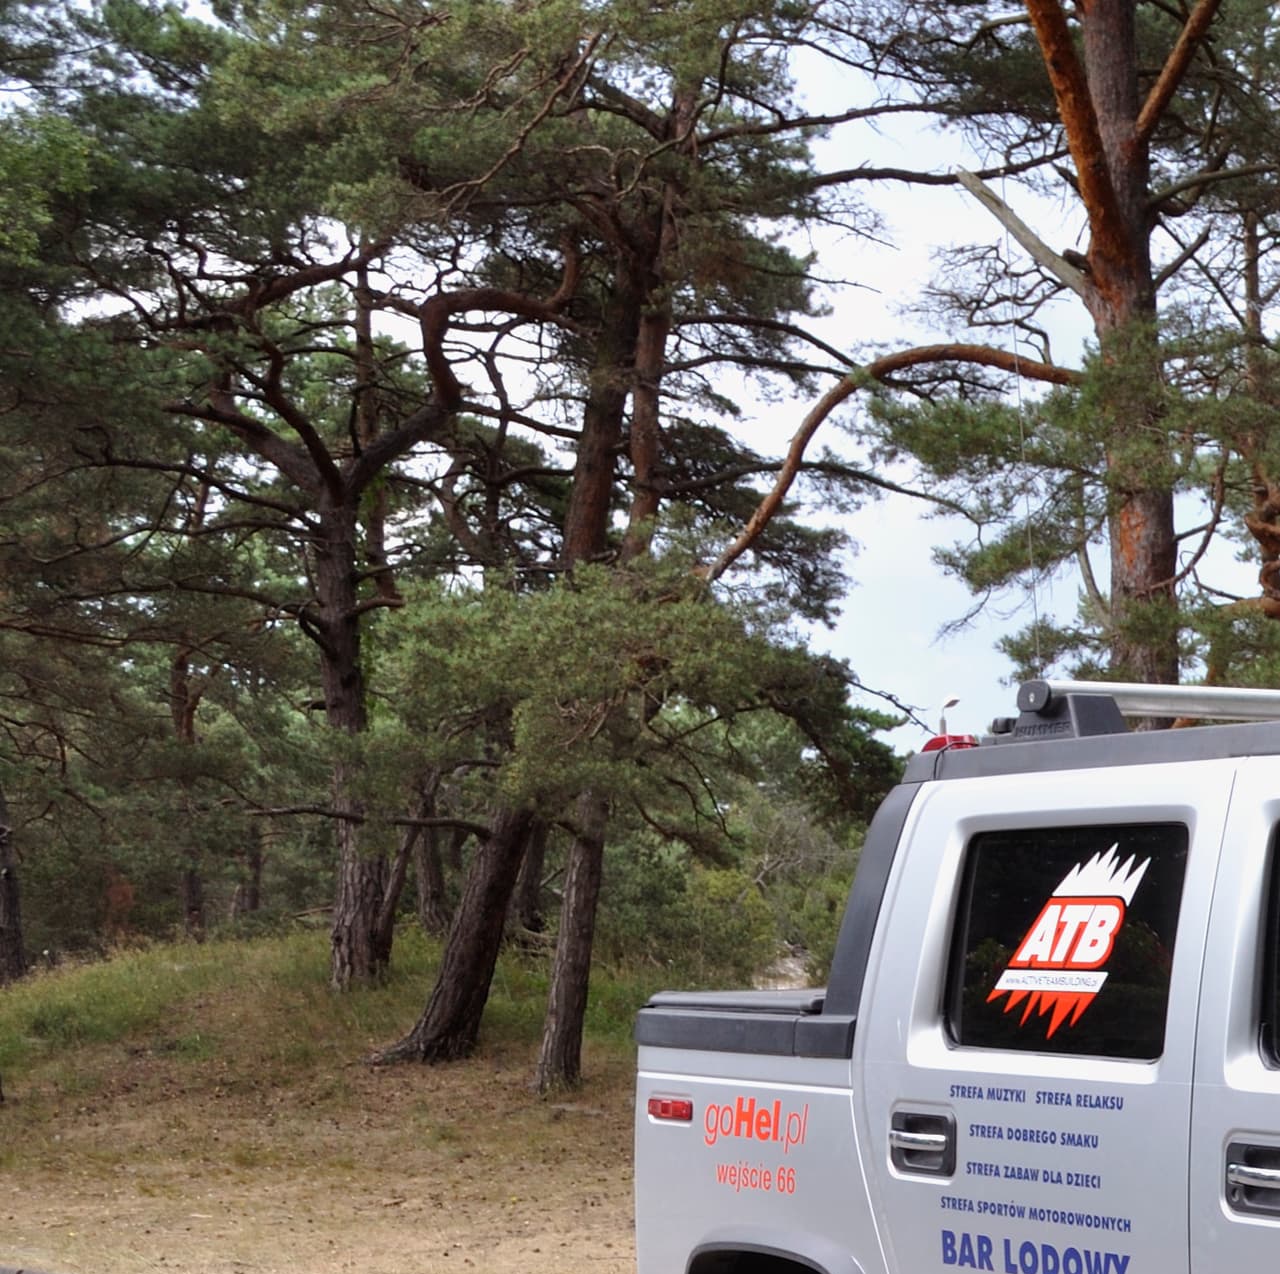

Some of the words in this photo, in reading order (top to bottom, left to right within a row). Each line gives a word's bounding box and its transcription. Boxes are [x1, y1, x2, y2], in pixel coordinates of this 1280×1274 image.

[1015, 904, 1121, 963] ATB
[950, 1085, 984, 1100] STREFA
[986, 1087, 1026, 1103] MUZYKI
[1036, 1091, 1072, 1107] STREFA
[1075, 1094, 1124, 1110] RELAKSU
[704, 1095, 809, 1154] goHel.pl
[969, 1124, 1004, 1140] STREFA
[1007, 1127, 1057, 1144] DOBREGO
[1060, 1132, 1099, 1149] SMAKU
[716, 1161, 771, 1192] wejście
[776, 1167, 796, 1194] 66
[966, 1162, 1001, 1178] STREFA
[1003, 1166, 1040, 1182] ZABAW
[1043, 1170, 1063, 1185] DLA
[1066, 1173, 1102, 1189] DZIECI
[941, 1196, 974, 1212] STREFA
[977, 1199, 1025, 1218] SPORTÓW
[1028, 1208, 1131, 1233] MOTOROWODNYCH
[941, 1230, 994, 1271] BAR
